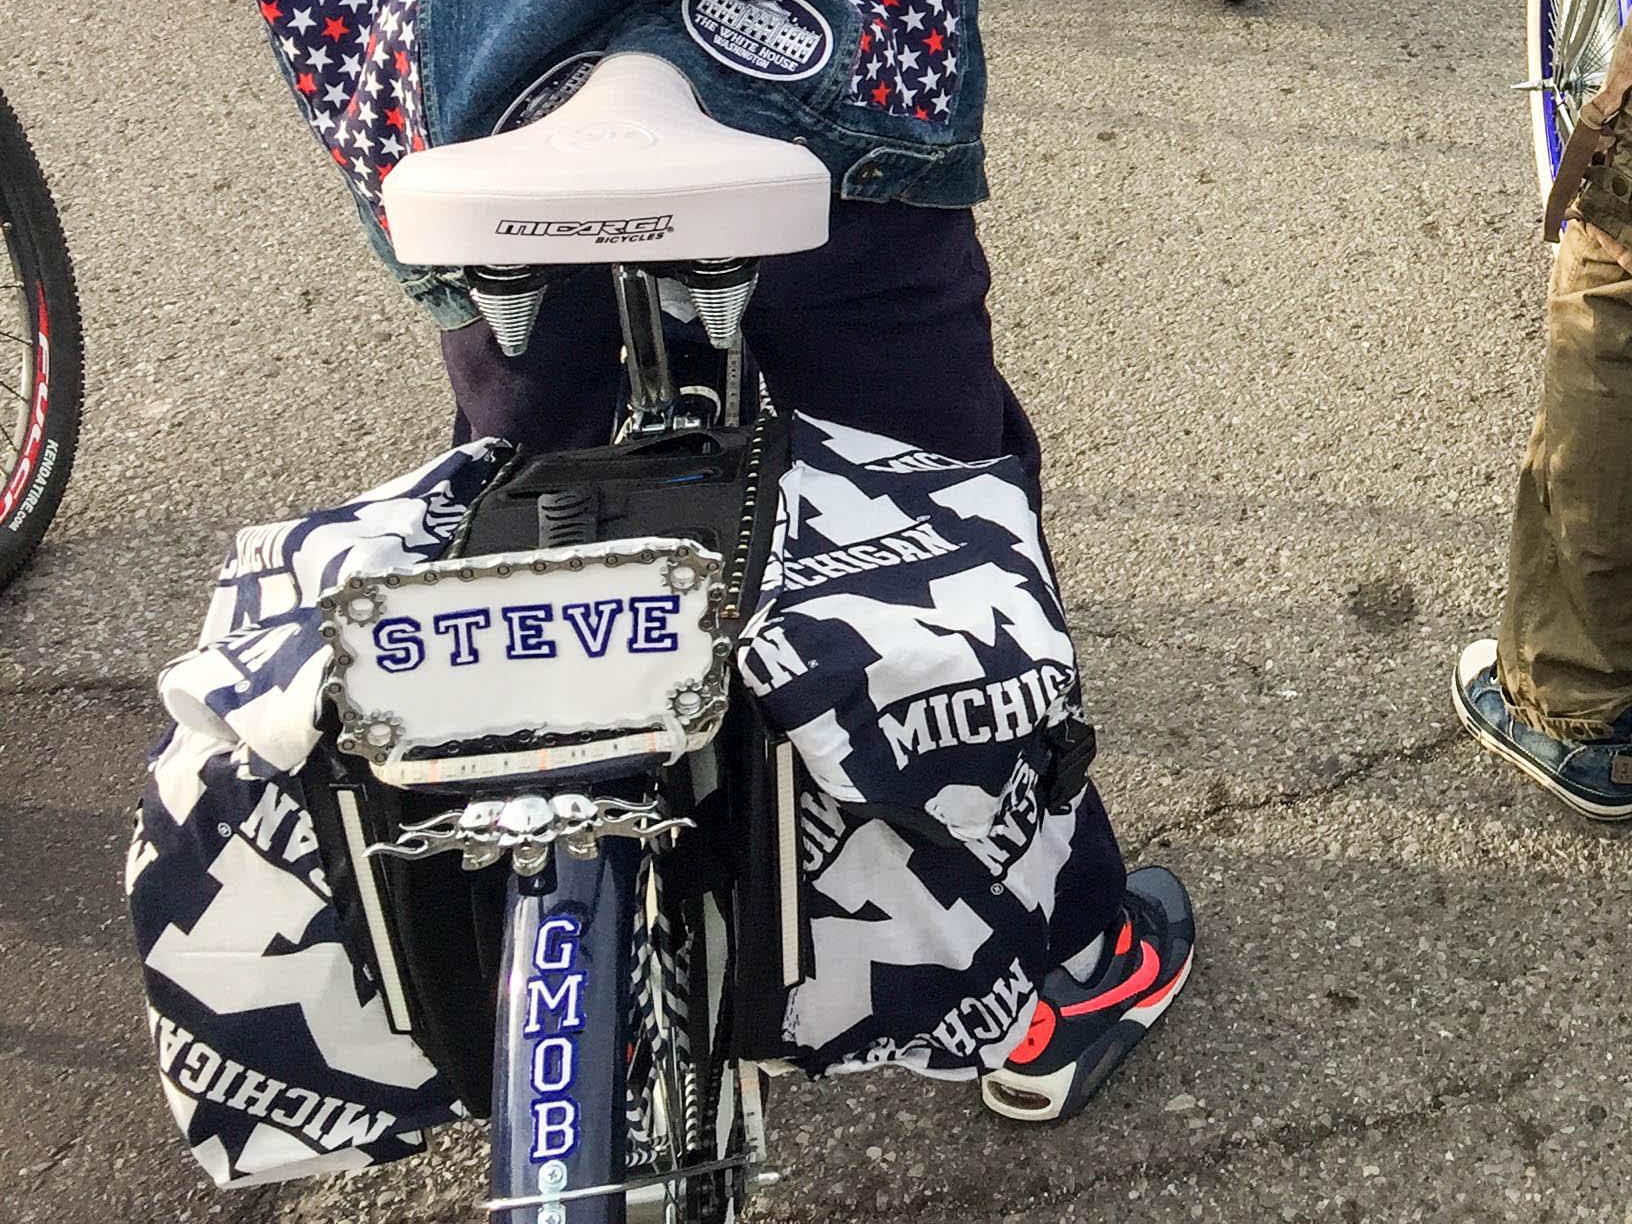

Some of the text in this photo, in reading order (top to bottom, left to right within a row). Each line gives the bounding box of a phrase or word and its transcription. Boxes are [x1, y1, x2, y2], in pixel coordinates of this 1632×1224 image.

[694, 14, 799, 72] THE WHITE HOUSE
[713, 34, 770, 69] WASHINGTON
[495, 214, 674, 238] MICARGI
[594, 231, 665, 244] BICYCLES
[9, 439, 59, 531] KENDATIRE.COM
[373, 594, 682, 674] STEVE
[524, 913, 588, 1164] GMOB
[152, 1010, 397, 1151] MICHIGA
